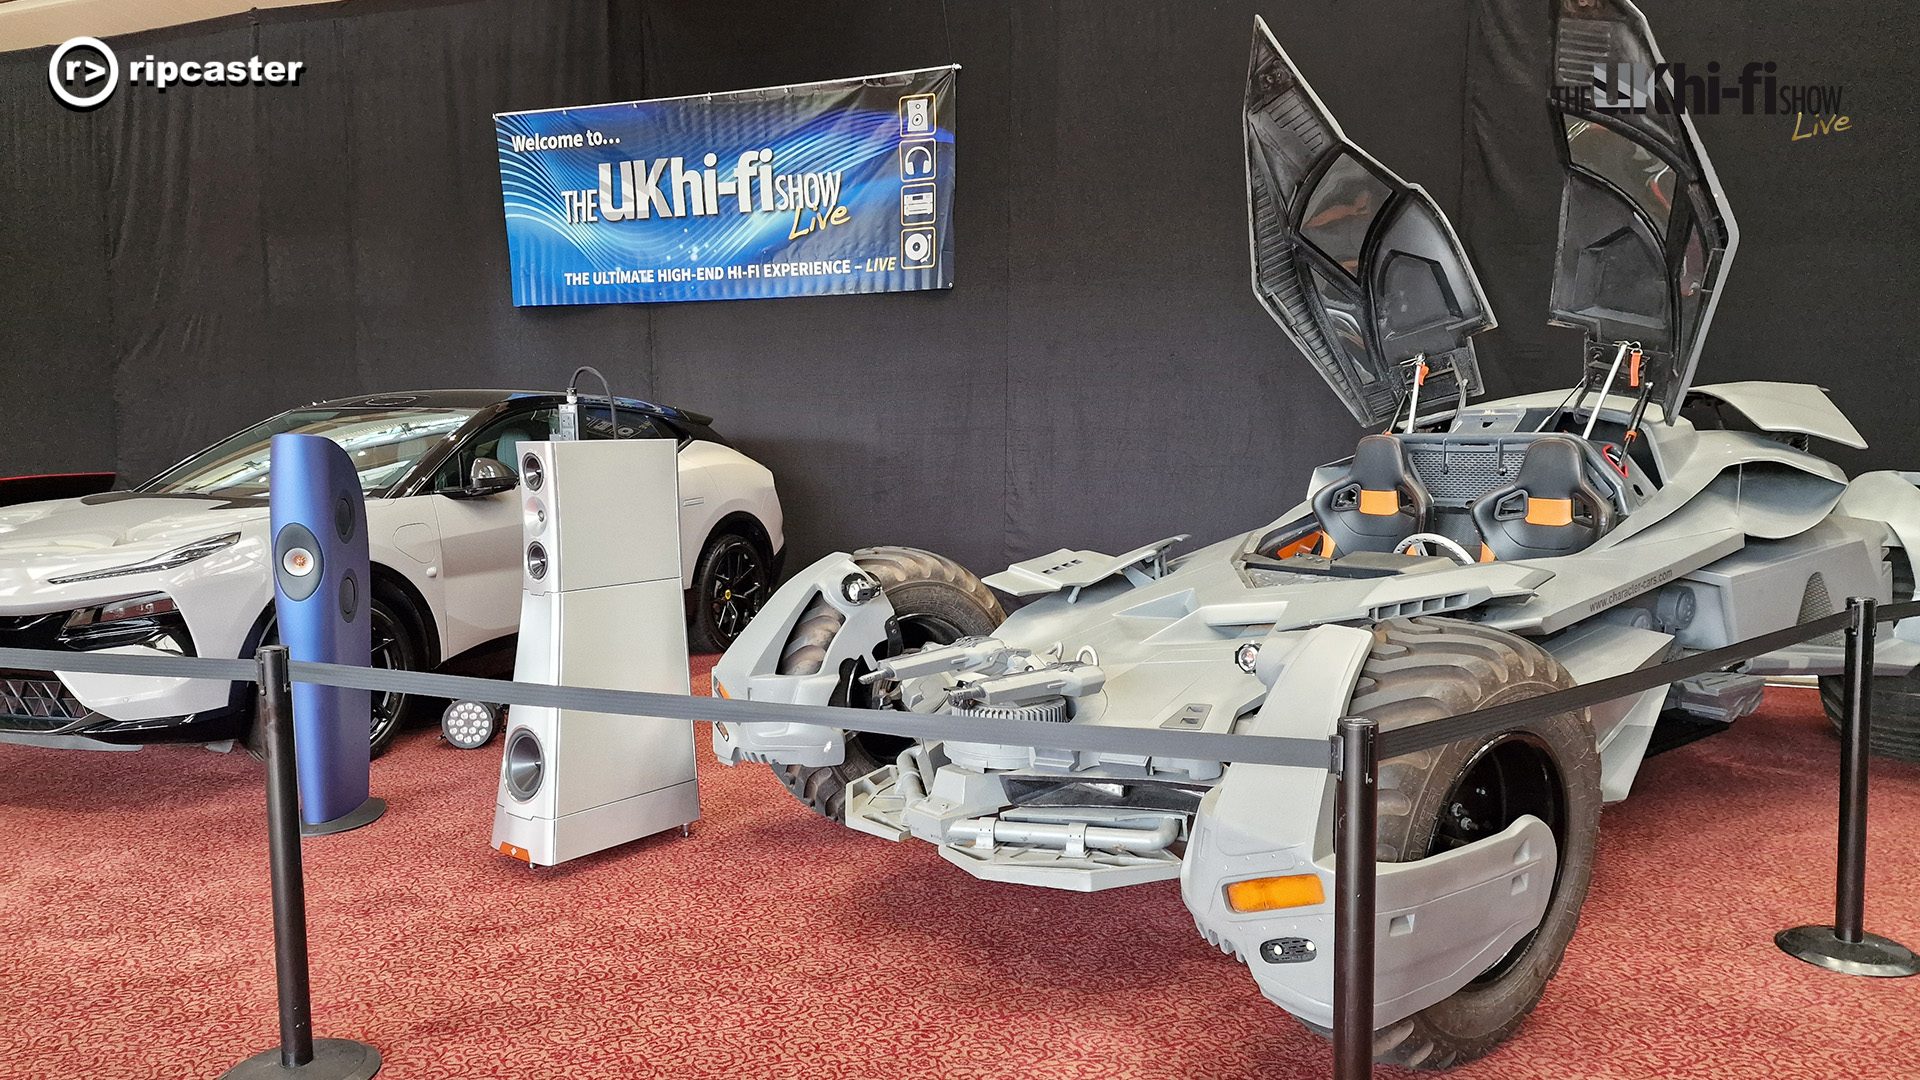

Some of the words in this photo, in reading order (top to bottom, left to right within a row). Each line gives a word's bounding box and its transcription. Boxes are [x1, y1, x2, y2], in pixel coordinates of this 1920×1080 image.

[511, 132, 584, 153] Welcome
[560, 188, 599, 224] THE
[774, 170, 842, 211] SHOW
[788, 203, 851, 241] Live
[564, 272, 590, 286] THE
[592, 269, 655, 286] ULTIMATE
[657, 266, 725, 283] HIGH-END
[727, 264, 760, 280] HI-FI
[763, 259, 851, 278] EXPERIENCE
[865, 256, 897, 273] LIVE
[1589, 569, 1673, 612] www.character-cars.com
